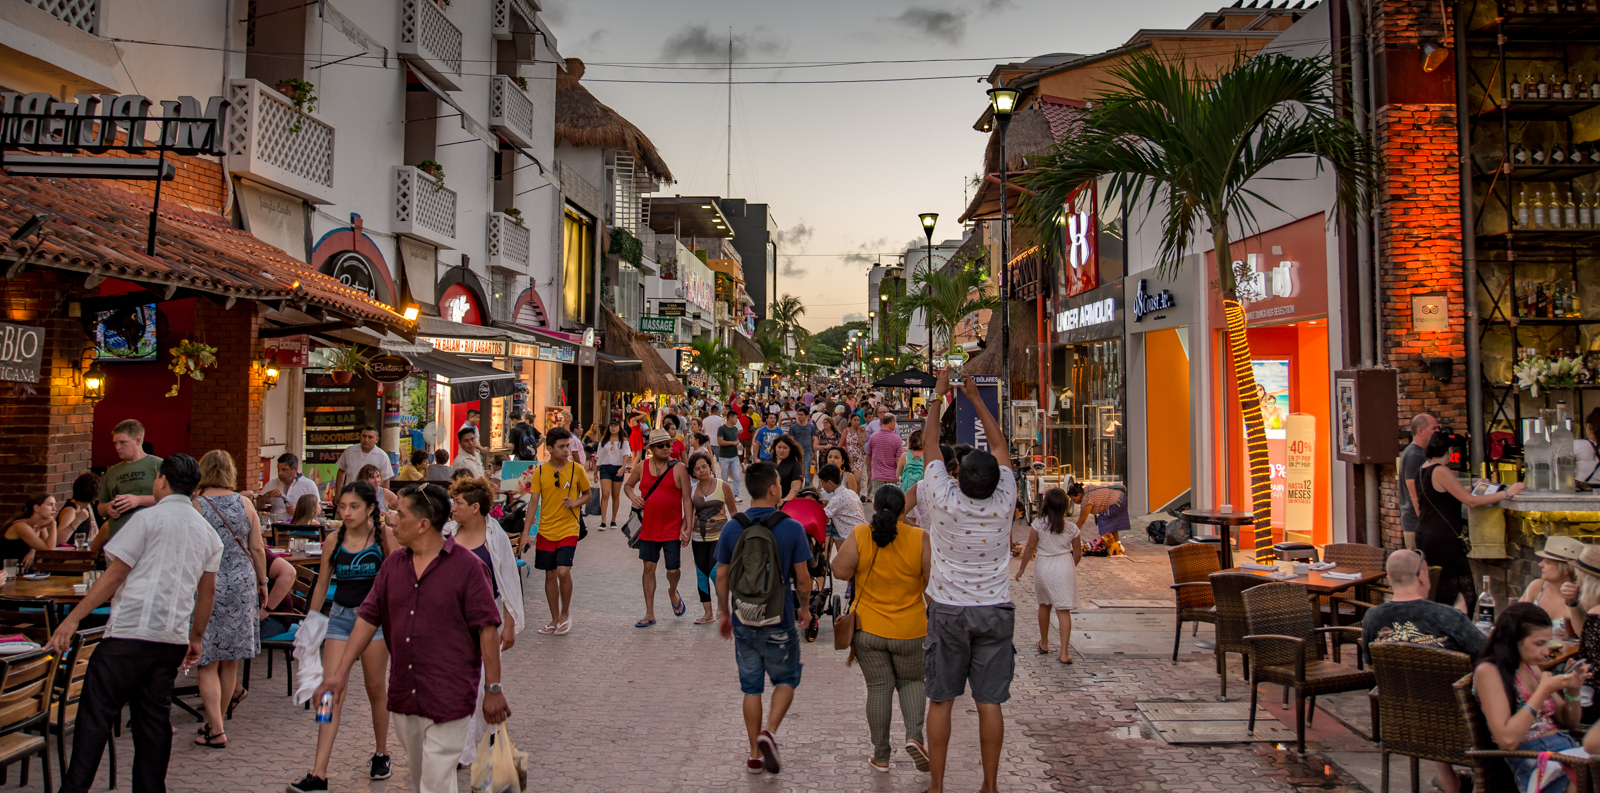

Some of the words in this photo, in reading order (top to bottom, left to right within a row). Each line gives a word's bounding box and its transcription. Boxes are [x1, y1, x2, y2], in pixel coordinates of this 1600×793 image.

[1056, 307, 1079, 332] UNDER
[1079, 297, 1115, 327] ARMOUR
[641, 318, 674, 332] MASSAGE
[280, 339, 302, 353] Exchange
[442, 339, 460, 351] BALAM
[475, 341, 503, 355] LAGARTOS
[371, 362, 404, 373] Bertoni
[976, 374, 999, 383] DÓLARES
[313, 414, 336, 424] JUICE
[337, 413, 357, 423] BAR
[310, 432, 361, 443] SMOOTHIES
[1288, 440, 1312, 454] -40%
[1288, 482, 1303, 490] HASTA
[1303, 480, 1312, 490] 12
[1288, 489, 1312, 500] MESES
